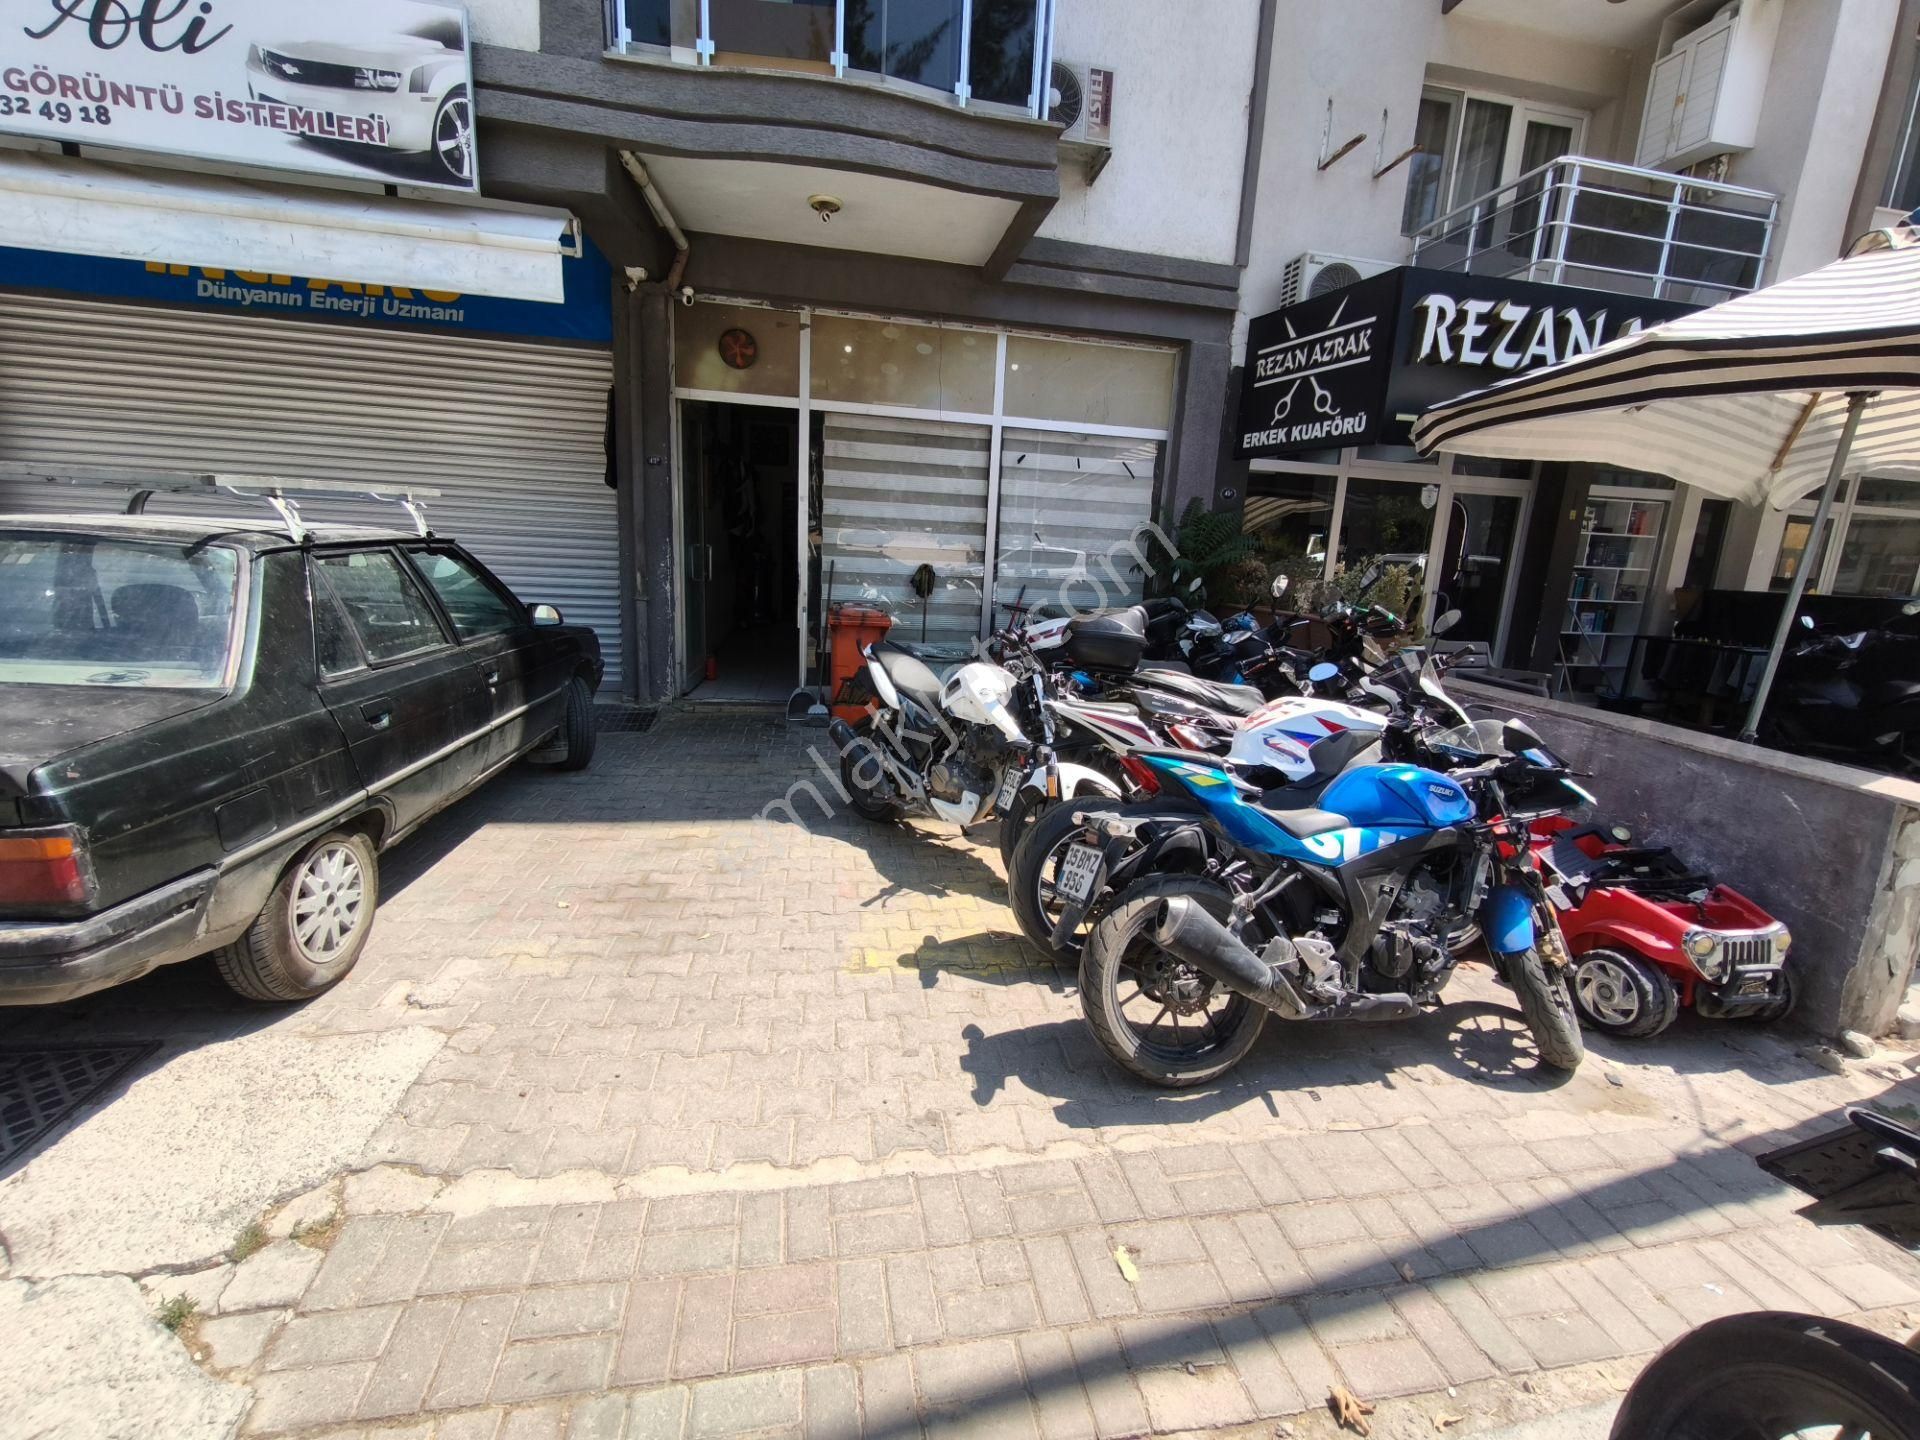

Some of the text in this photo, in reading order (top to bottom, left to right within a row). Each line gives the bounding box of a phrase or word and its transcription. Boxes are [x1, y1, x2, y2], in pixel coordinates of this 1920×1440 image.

[3, 64, 386, 144] GÖRÜNTÜ SİSTEMLERİ
[38, 101, 72, 123] 49
[79, 105, 111, 125] 18
[1087, 71, 1104, 132] VESTEL
[197, 279, 302, 306] Dünyanın
[309, 291, 376, 317] Enerji
[382, 298, 464, 322] Uzmanı
[1416, 293, 1608, 369] REZAN
[1256, 328, 1372, 378] REZAN AZRAK
[1243, 412, 1367, 448] ERKEK KUAFÖRÜ
[1429, 784, 1454, 797] SUZUKI
[1066, 847, 1100, 874] 35 BMZ
